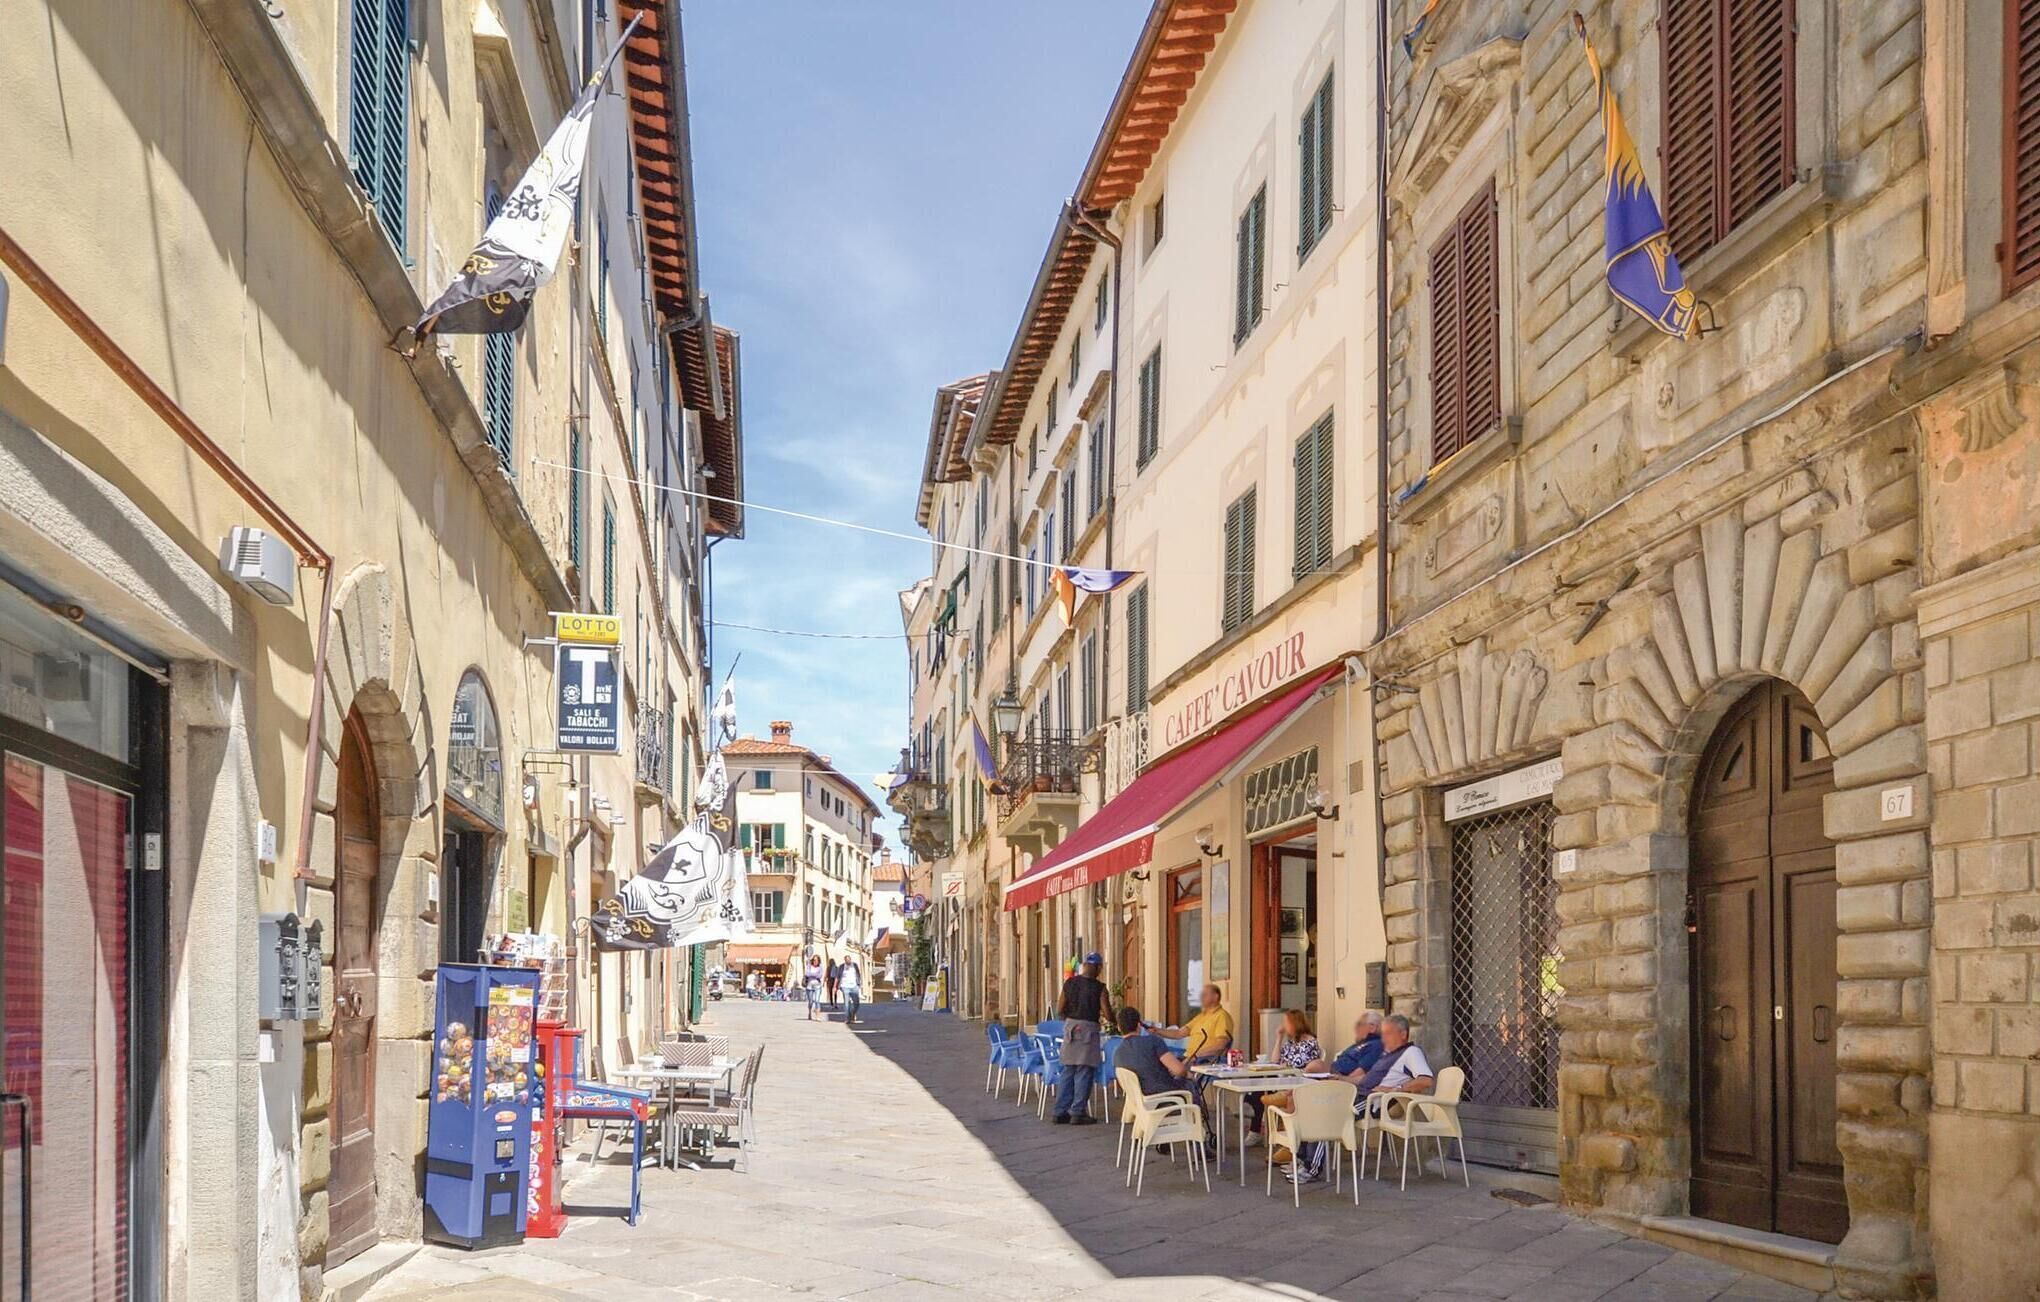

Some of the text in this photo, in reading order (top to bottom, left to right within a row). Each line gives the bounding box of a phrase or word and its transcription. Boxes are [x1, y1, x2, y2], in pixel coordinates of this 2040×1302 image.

[562, 618, 616, 633] LOTTO
[569, 649, 609, 704] T
[1165, 631, 1306, 747] CAFFE' CAVOUR
[573, 708, 601, 717] SALI E
[567, 716, 608, 728] TABACCHI
[559, 735, 615, 745] VALORI BOLLATI
[1886, 794, 1905, 814] 67
